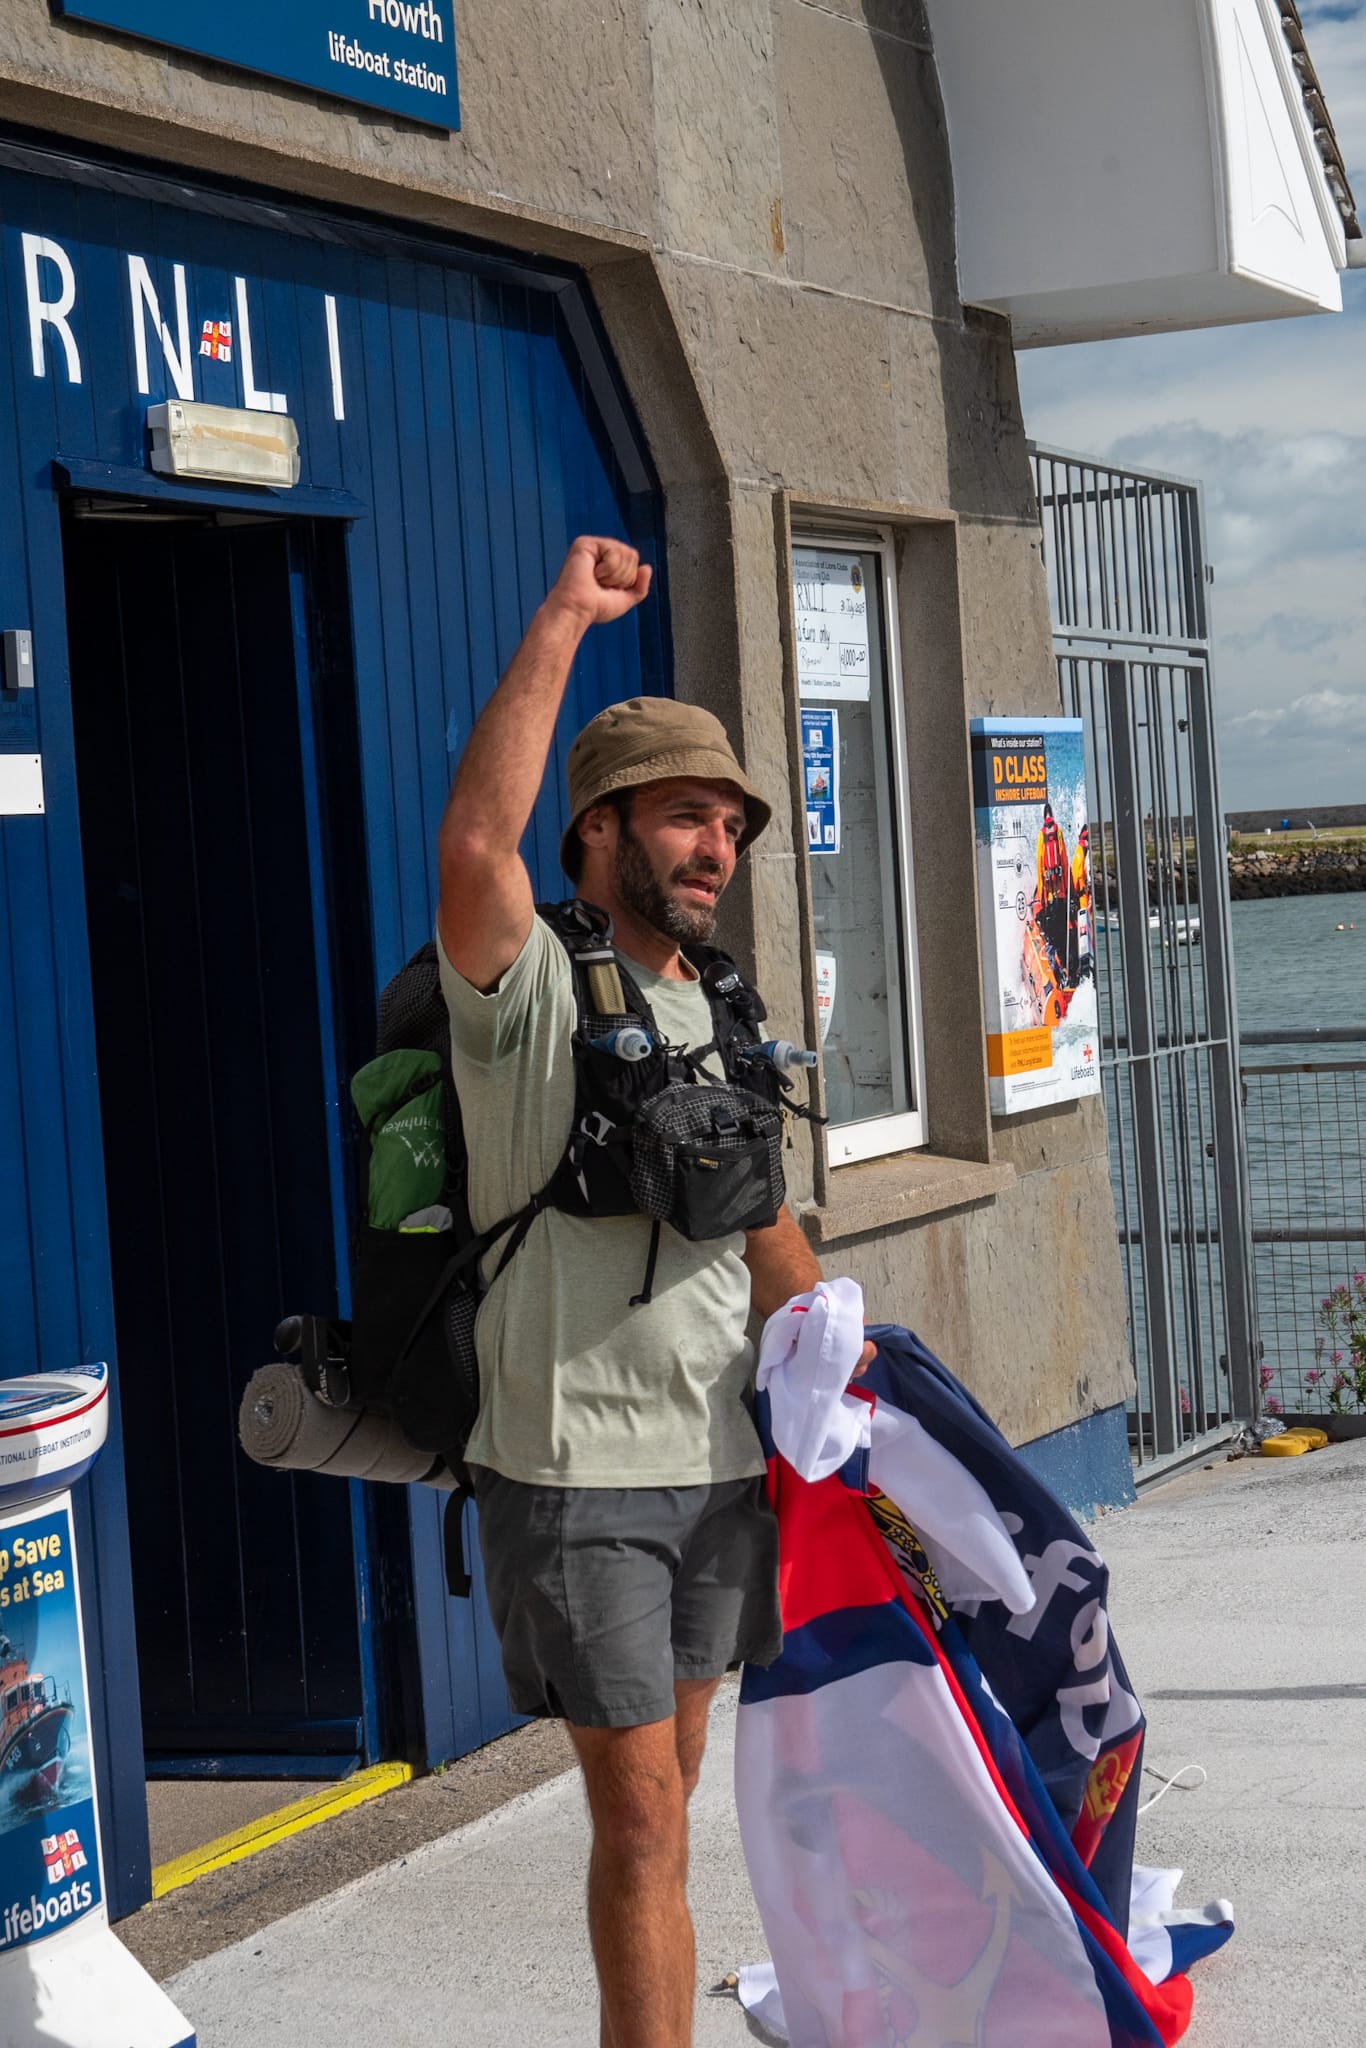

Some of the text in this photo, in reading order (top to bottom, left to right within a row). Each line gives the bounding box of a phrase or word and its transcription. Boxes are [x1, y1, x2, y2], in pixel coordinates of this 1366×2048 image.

[328, 30, 447, 96] lifeboat station
[993, 755, 1046, 784] D CLASS
[995, 787, 1047, 801] INSHORE LIFEBOAT
[1071, 1065, 1095, 1081] Lifeboats
[28, 1441, 59, 1460] LIFEBOAT
[59, 1428, 92, 1450] INSTITUTION
[13, 1533, 61, 1568] Save
[13, 1576, 30, 1603] at
[32, 1569, 65, 1597] Sea
